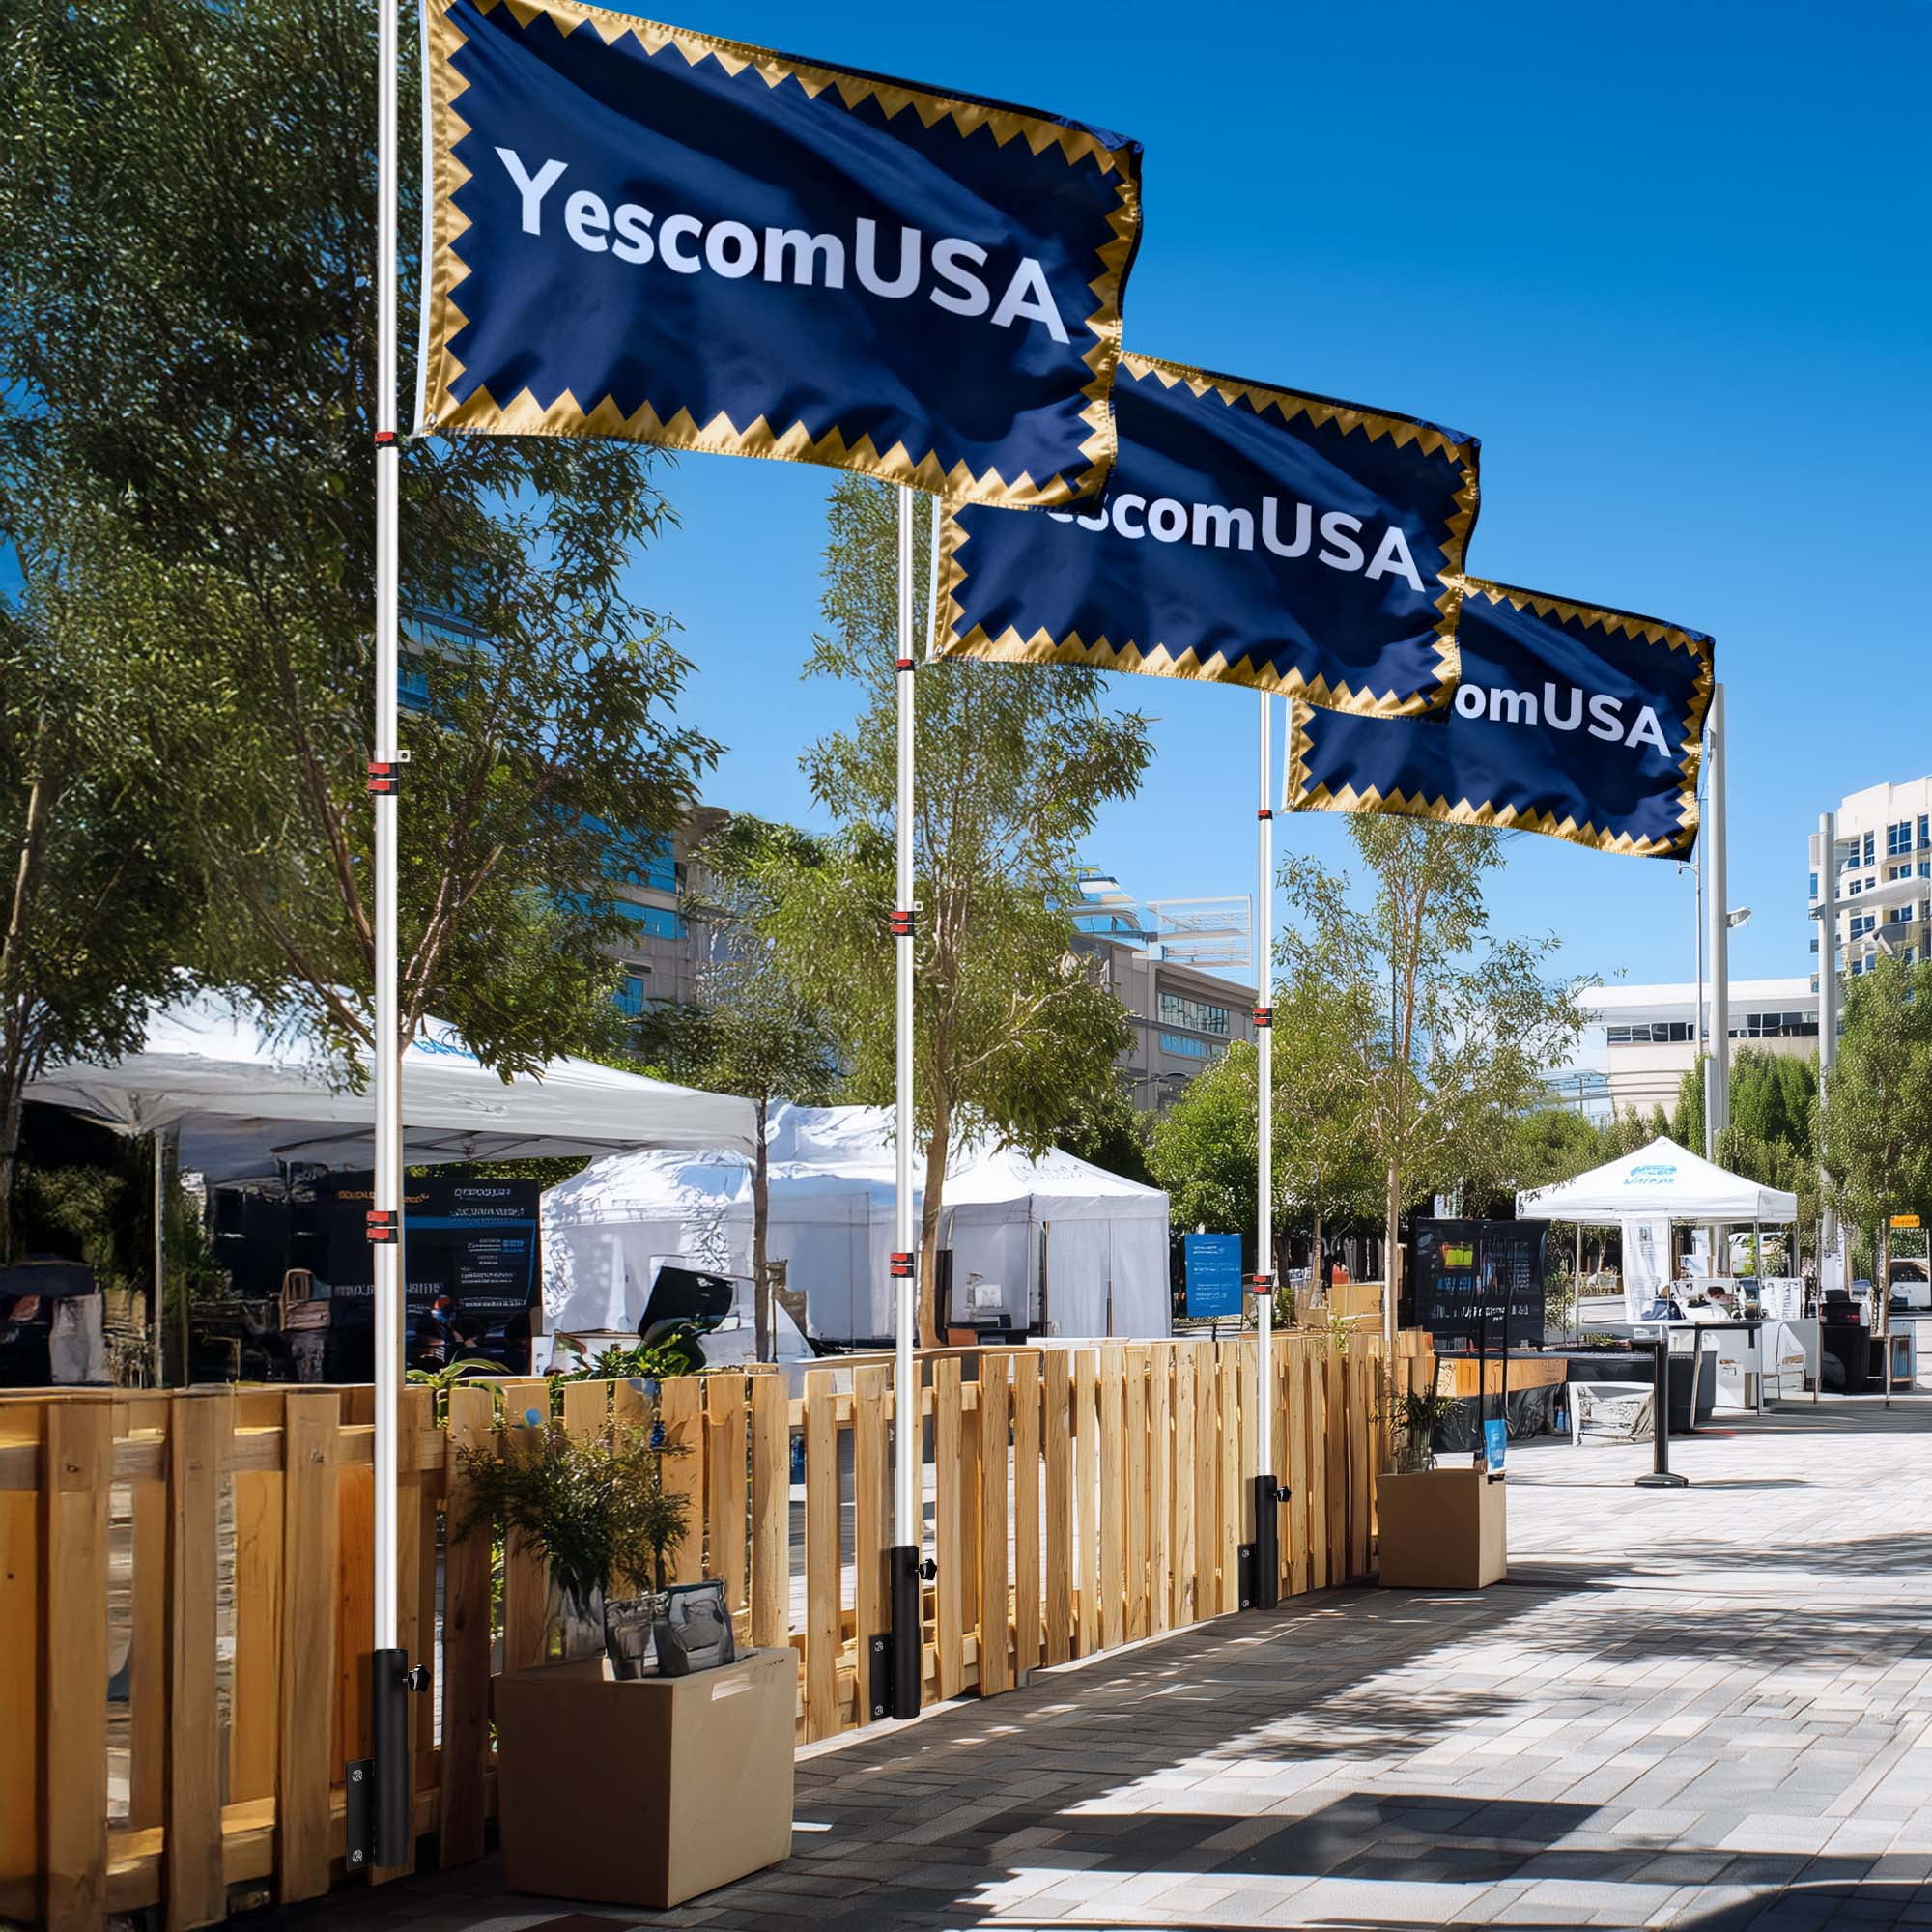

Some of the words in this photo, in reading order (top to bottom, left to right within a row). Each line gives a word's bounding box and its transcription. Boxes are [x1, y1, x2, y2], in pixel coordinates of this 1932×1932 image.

[495, 147, 1069, 343] YescomUSA
[1048, 495, 1425, 592] comUSA
[1452, 682, 1671, 757] omUSA
